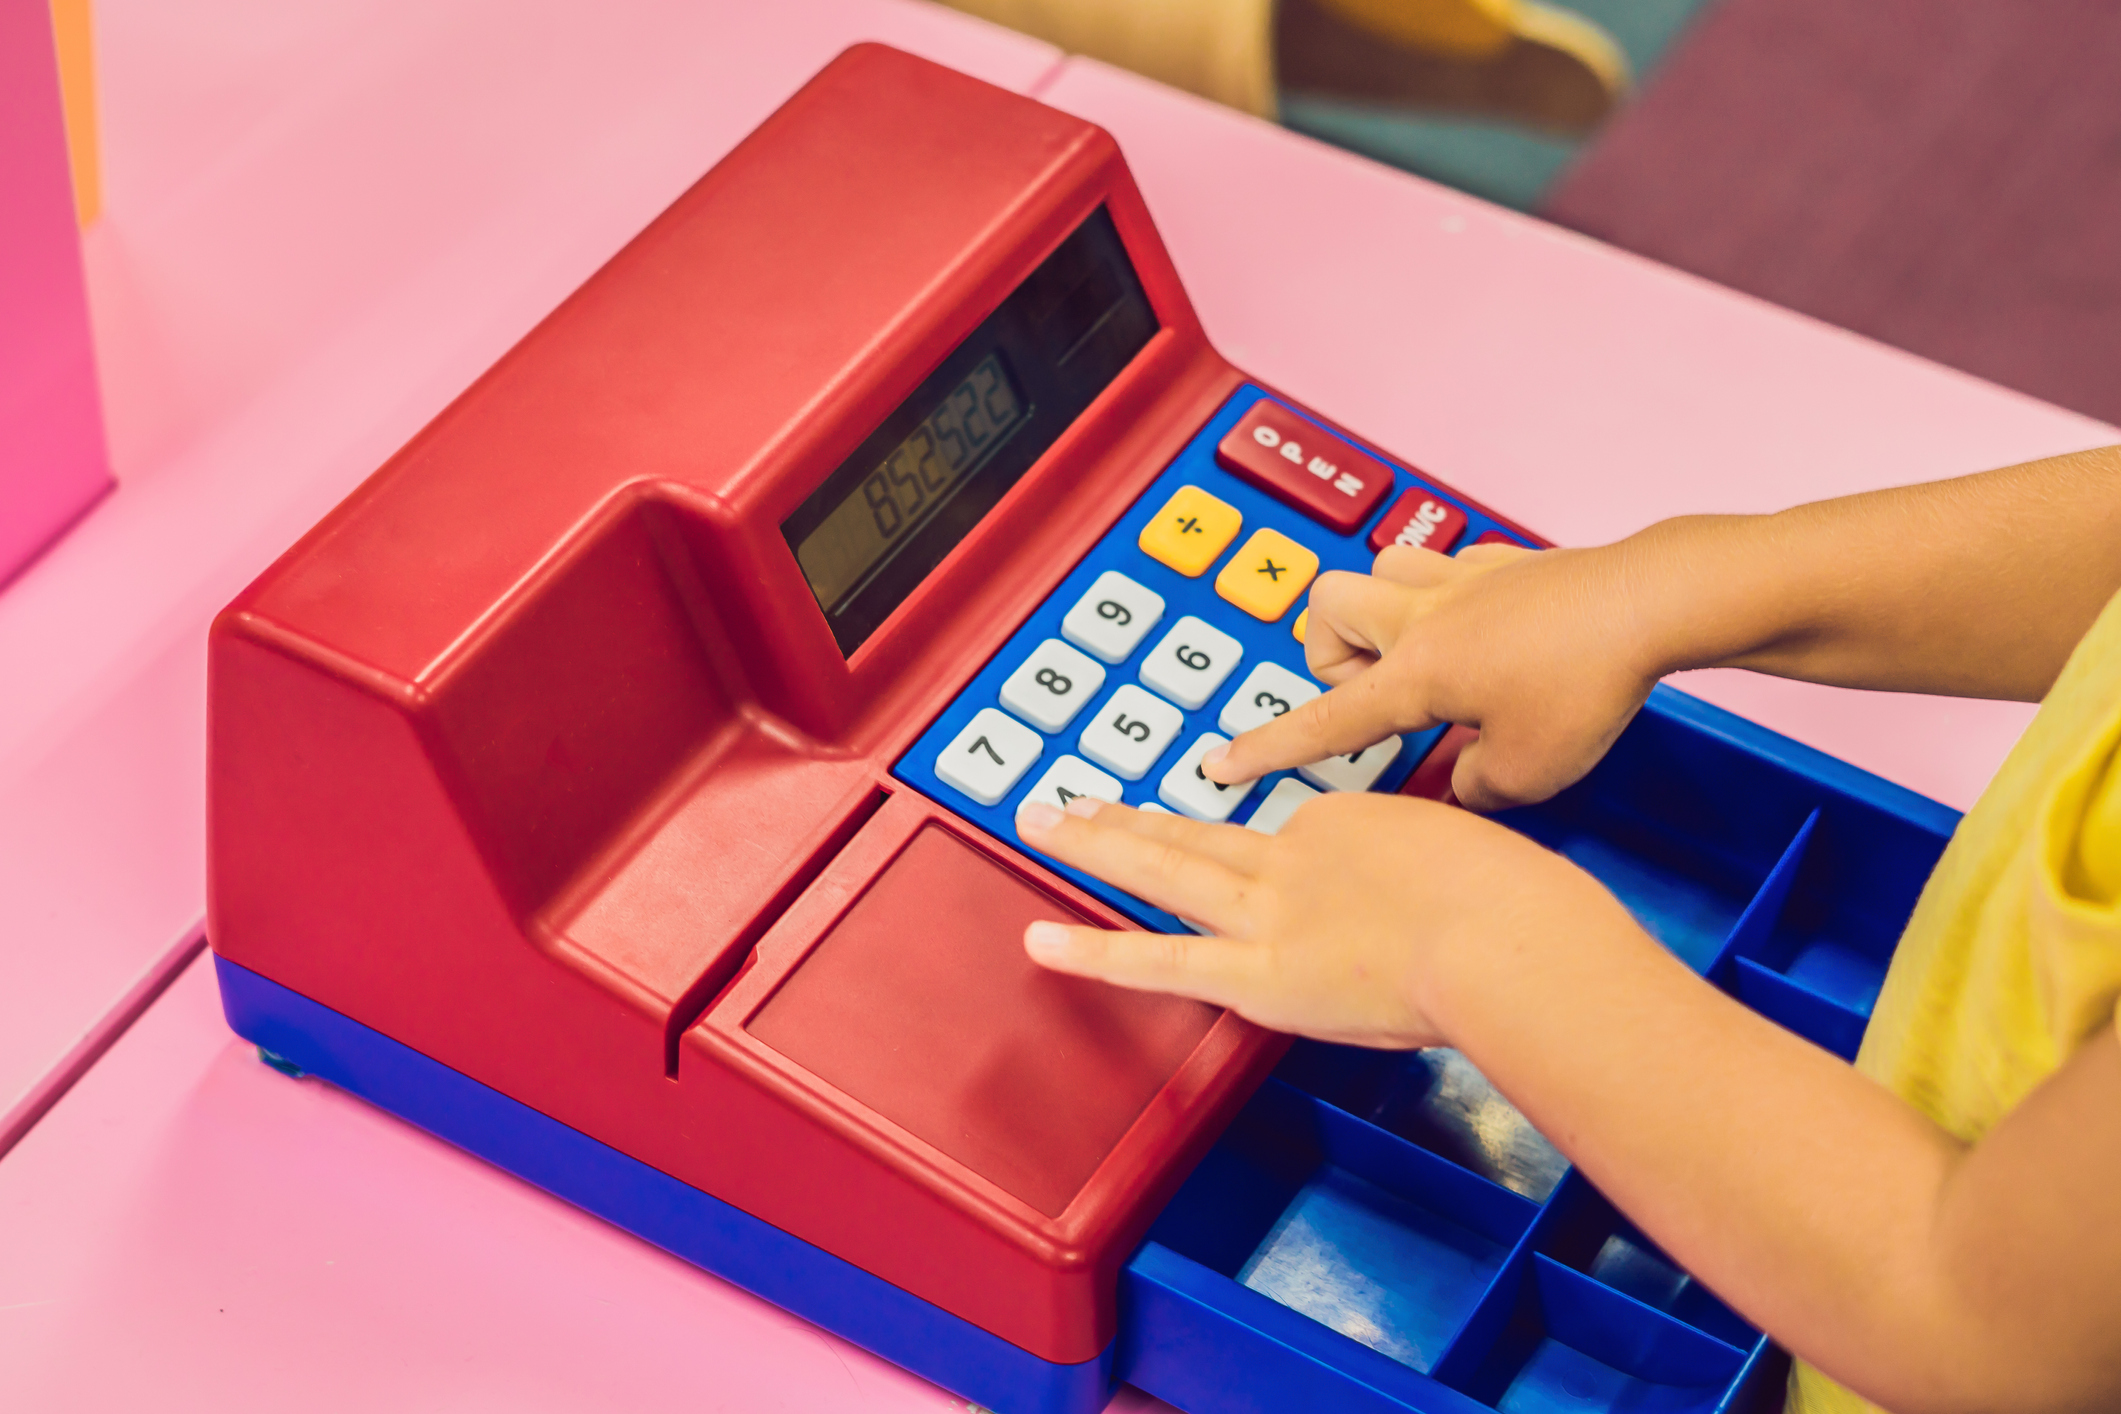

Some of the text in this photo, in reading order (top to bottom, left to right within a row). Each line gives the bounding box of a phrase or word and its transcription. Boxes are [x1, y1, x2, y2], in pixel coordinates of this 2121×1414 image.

[862, 354, 1011, 539] 852522
[1252, 425, 1365, 498] OPEN
[1096, 600, 1132, 626] 9
[1175, 645, 1211, 671] 6
[1035, 668, 1072, 695] 8
[1254, 691, 1291, 717] 3
[1112, 713, 1151, 742] 5
[967, 735, 1005, 766] 7
